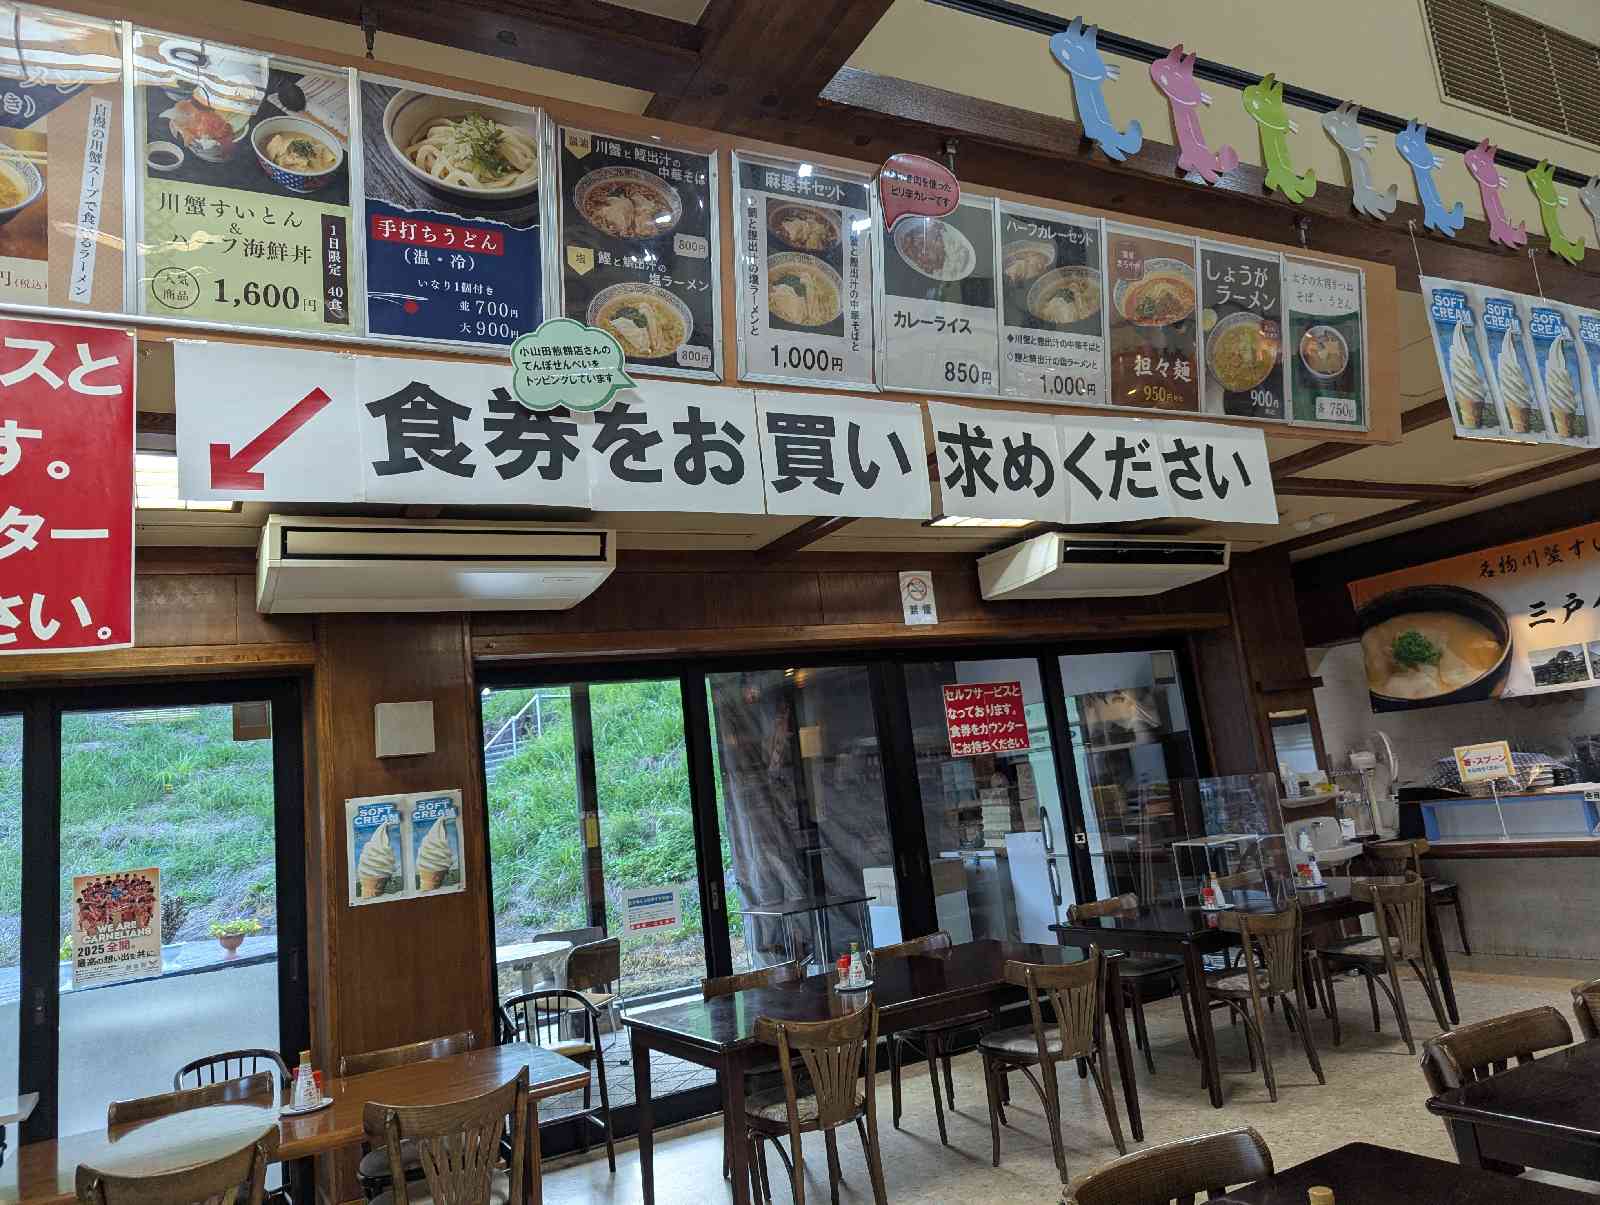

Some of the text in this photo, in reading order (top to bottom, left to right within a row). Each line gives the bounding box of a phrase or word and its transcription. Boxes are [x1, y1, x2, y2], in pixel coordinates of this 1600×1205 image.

[159, 191, 303, 228] 川蟹すいとん
[229, 222, 243, 236] &
[377, 219, 498, 251] 手打ちうどん
[1006, 222, 1094, 248] ハーフカレーセット
[648, 273, 710, 293] 塩ラーメン
[1205, 259, 1269, 289] しょうが
[1214, 286, 1277, 312] ラーメン
[1434, 294, 1465, 309] SOFT
[1485, 303, 1514, 318] SOFT
[893, 310, 973, 336] カレーライス
[1528, 592, 1600, 629] 三戸
[359, 806, 392, 818] SOFT
